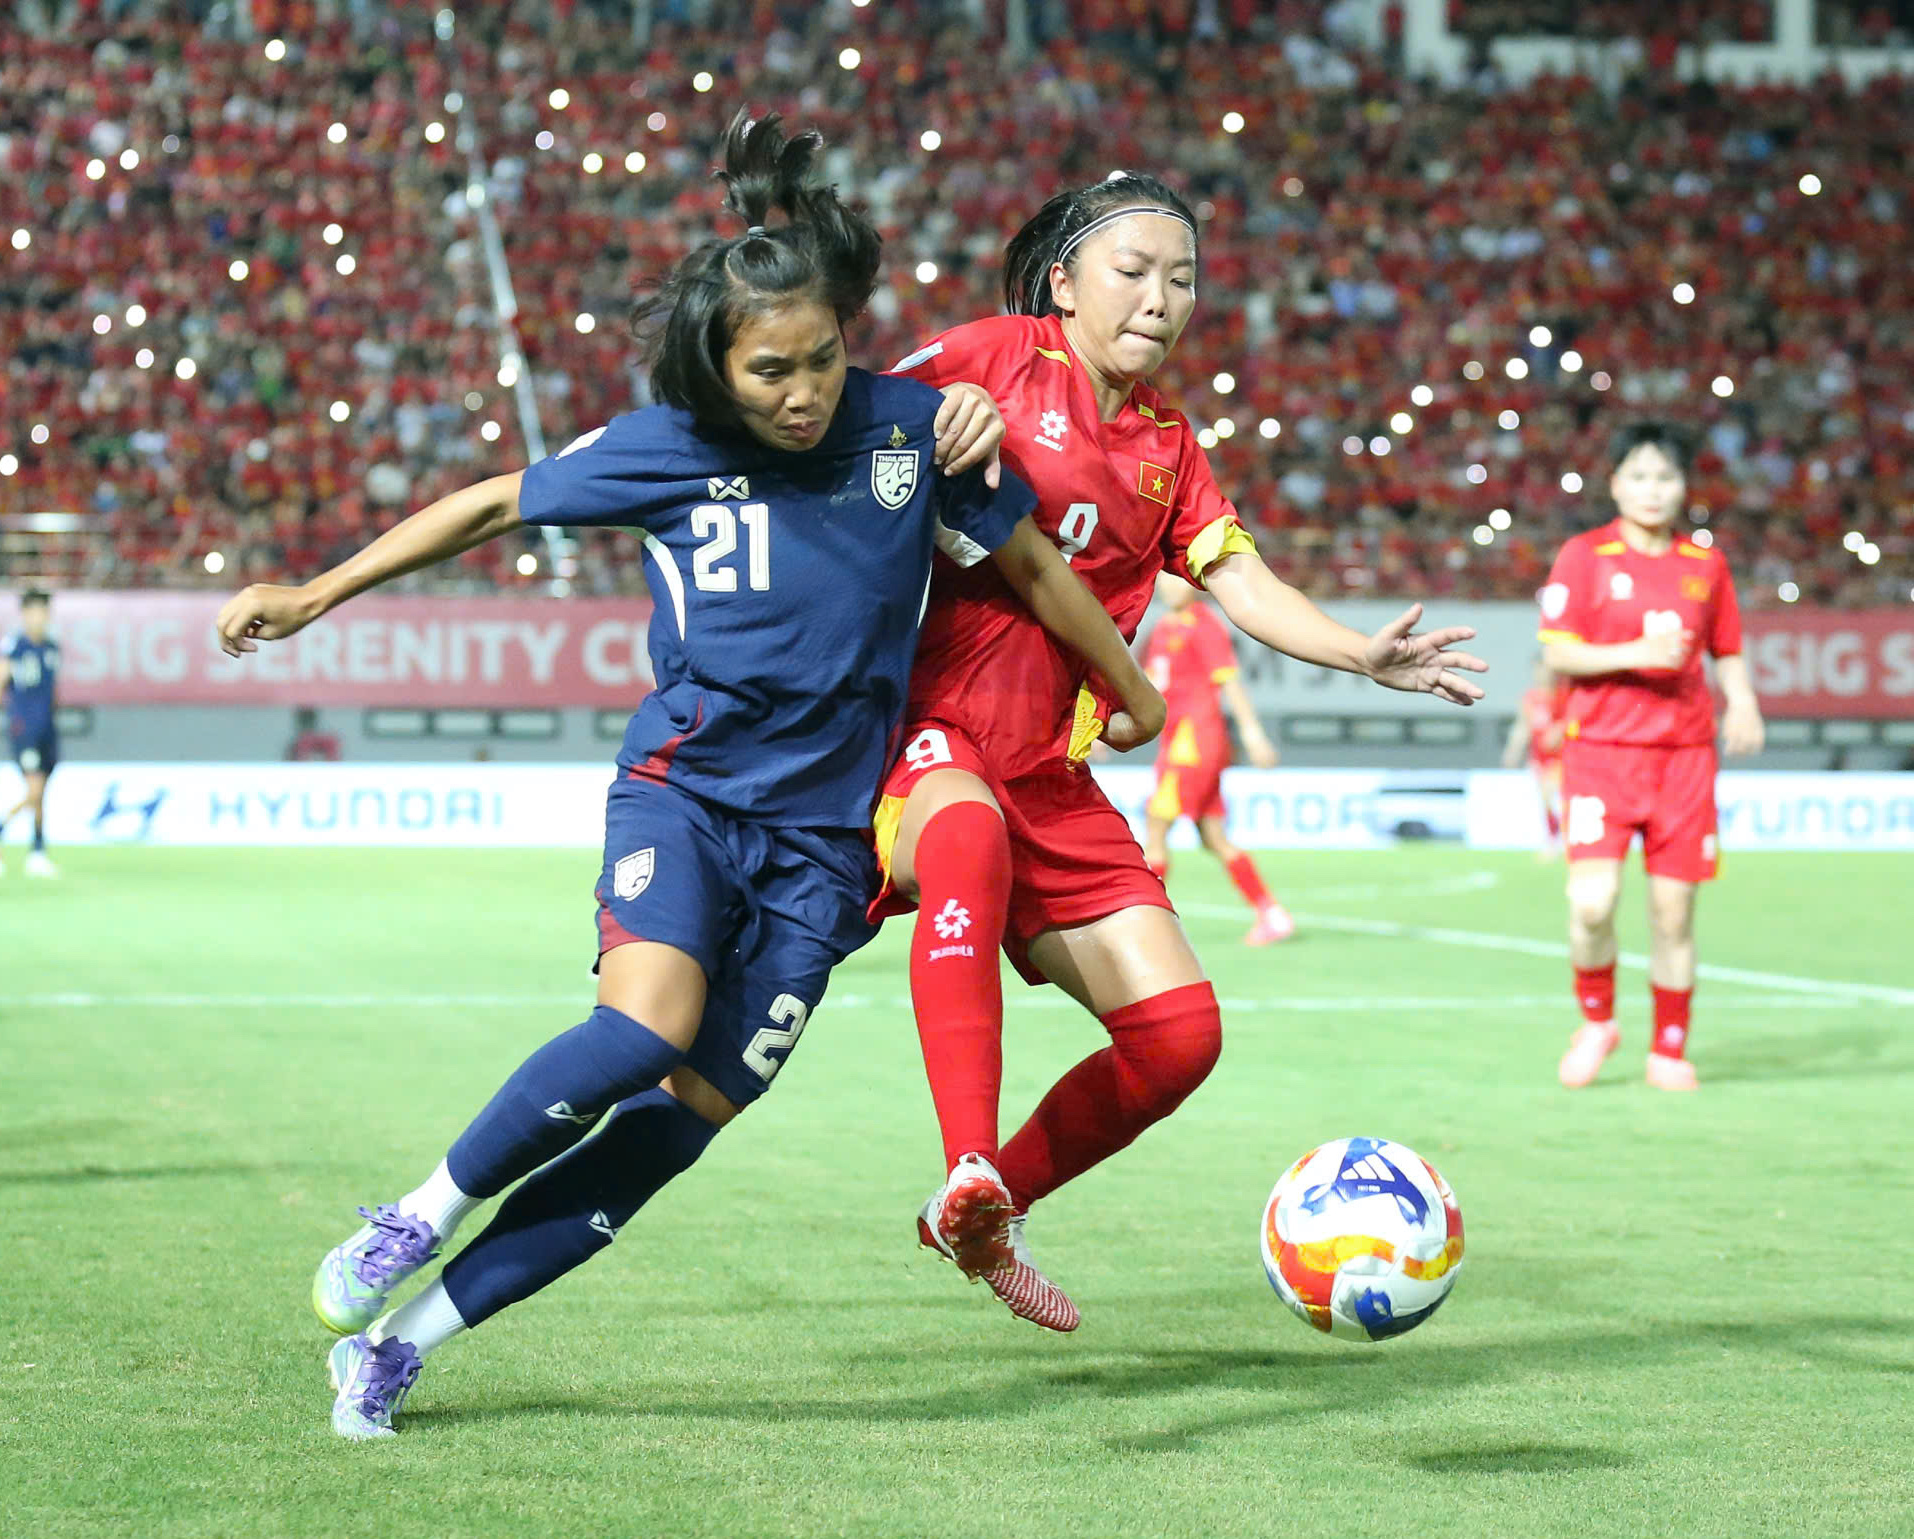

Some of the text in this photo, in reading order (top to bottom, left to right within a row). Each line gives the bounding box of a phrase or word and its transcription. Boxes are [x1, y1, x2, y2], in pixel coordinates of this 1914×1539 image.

[877, 455, 914, 463] THAILAND
[691, 503, 770, 592] 21
[48, 617, 188, 685] SIG
[1741, 629, 1914, 697] SIG S
[905, 729, 953, 771] 9
[209, 789, 506, 831] HYUNDAI
[742, 993, 807, 1082] 2
